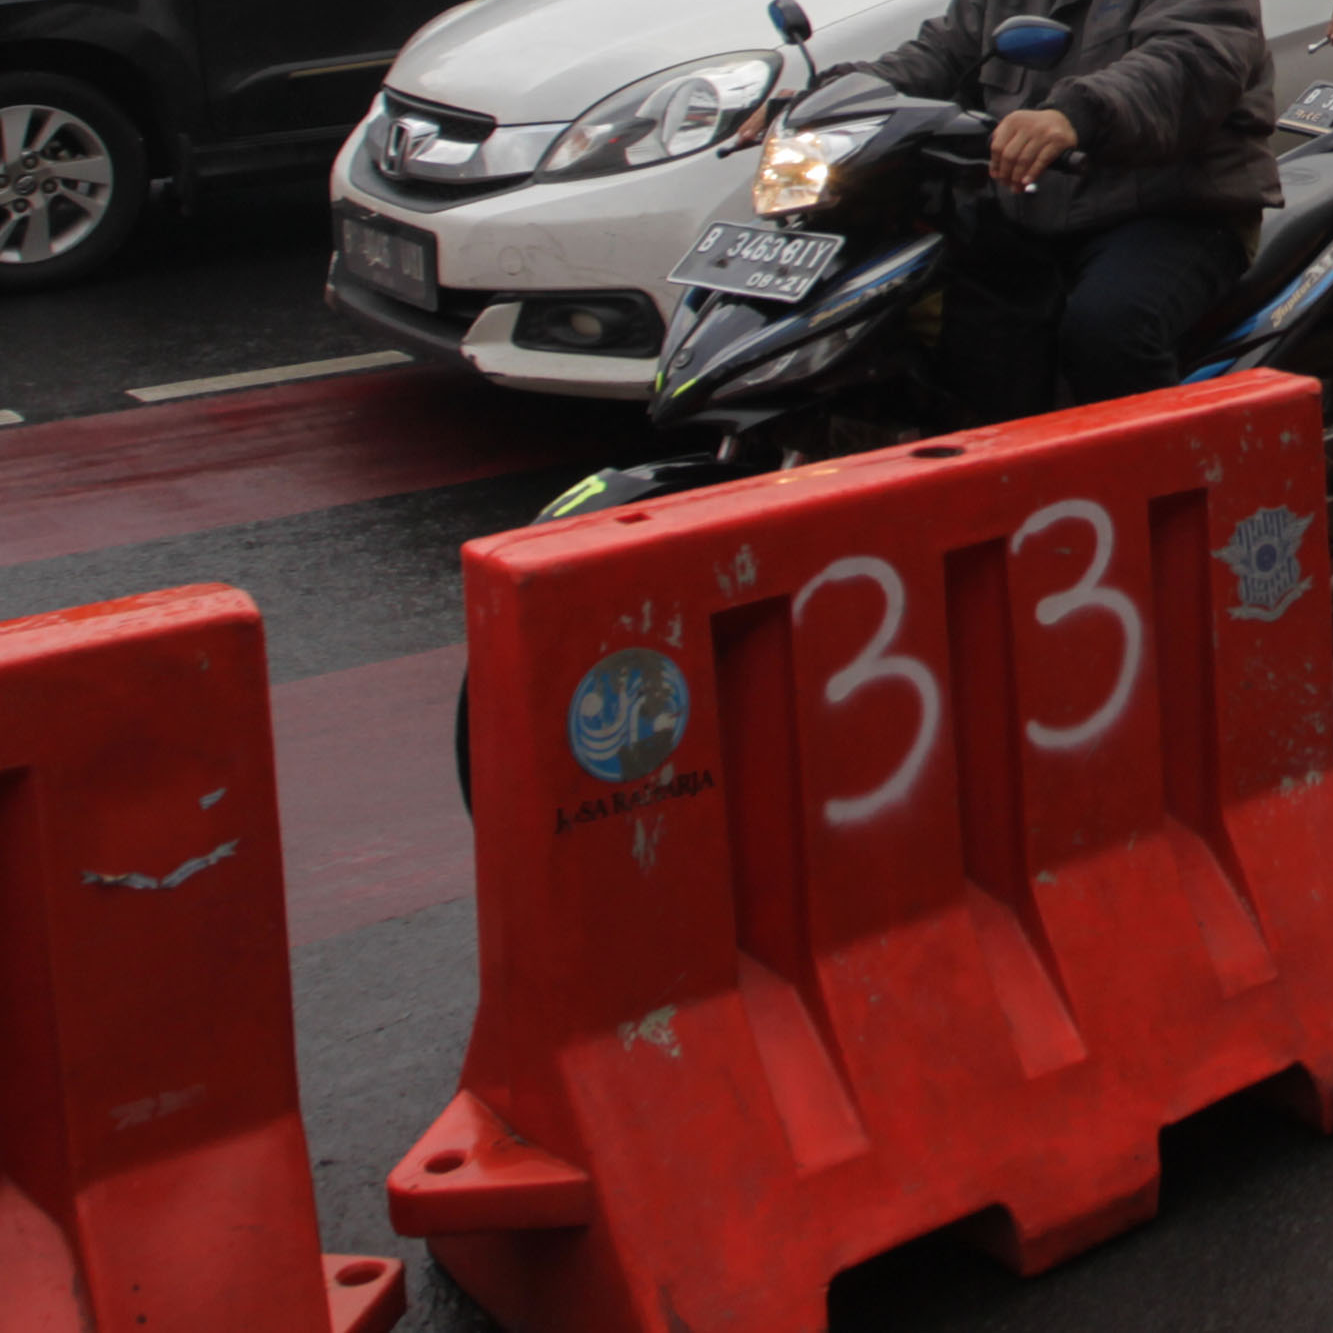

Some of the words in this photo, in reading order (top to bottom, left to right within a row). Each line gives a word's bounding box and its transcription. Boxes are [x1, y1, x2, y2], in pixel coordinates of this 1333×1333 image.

[1303, 88, 1322, 105] B
[697, 227, 724, 253] B
[726, 232, 788, 263] 3463
